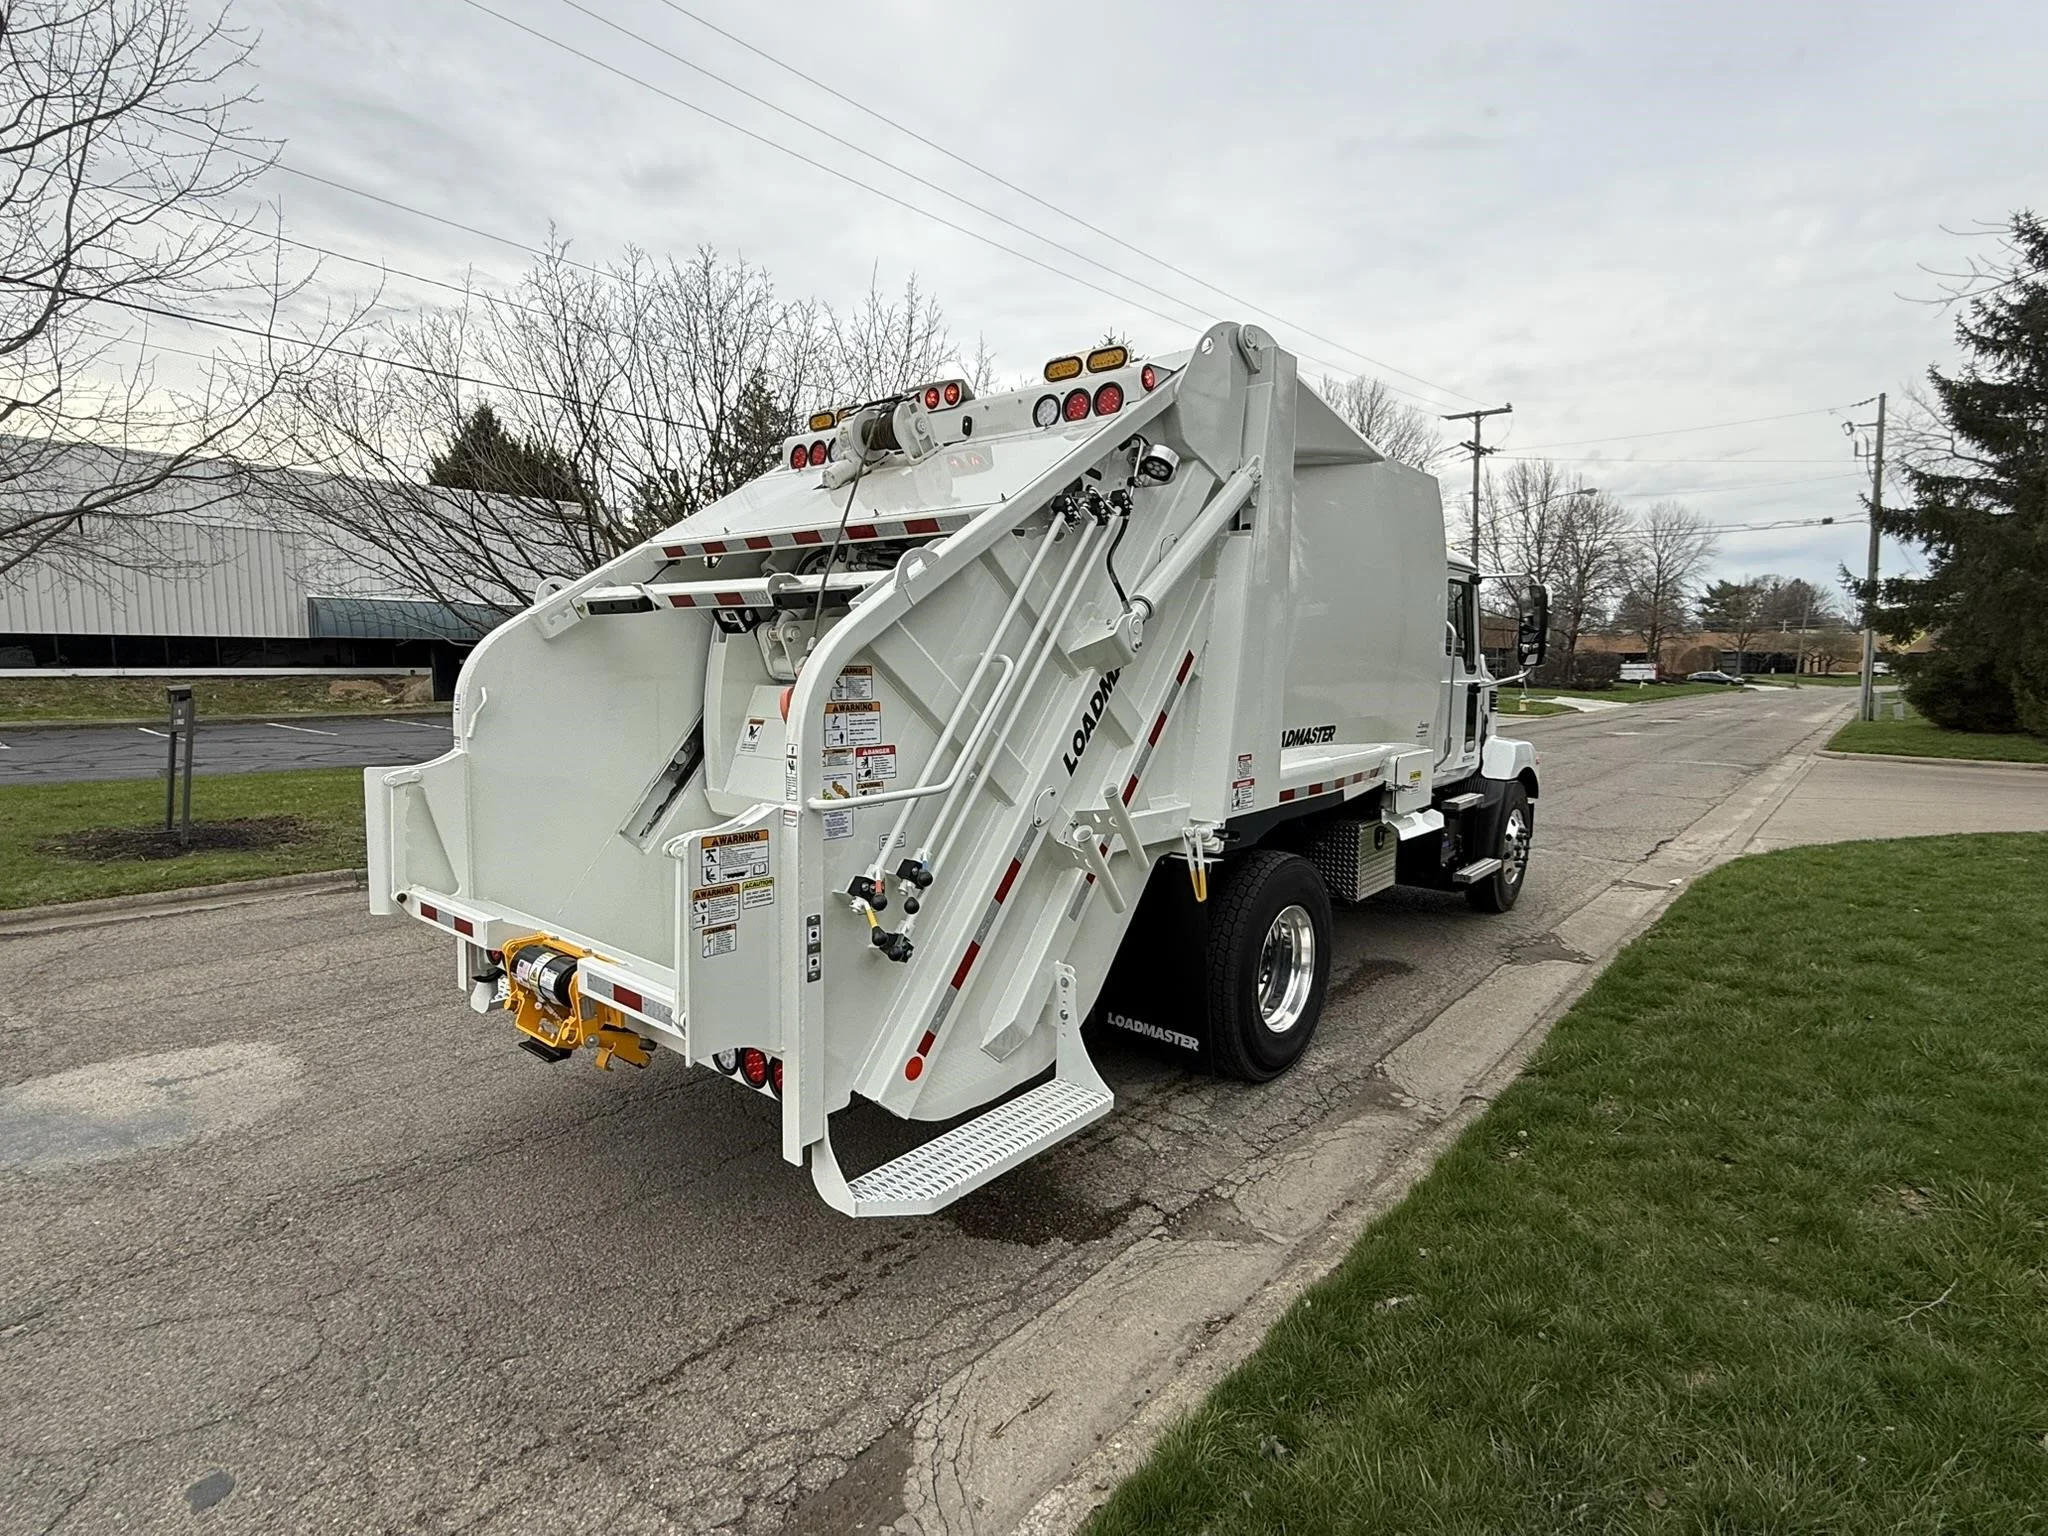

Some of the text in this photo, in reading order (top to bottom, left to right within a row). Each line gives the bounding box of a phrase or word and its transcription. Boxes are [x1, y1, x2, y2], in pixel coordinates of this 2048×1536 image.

[838, 703, 873, 712] WARNING
[867, 747, 890, 756] DANGER
[719, 831, 760, 846] WARNING
[748, 879, 773, 889] CAUTION
[700, 885, 734, 898] WARNING
[1106, 1011, 1200, 1052] LOADMASTER
